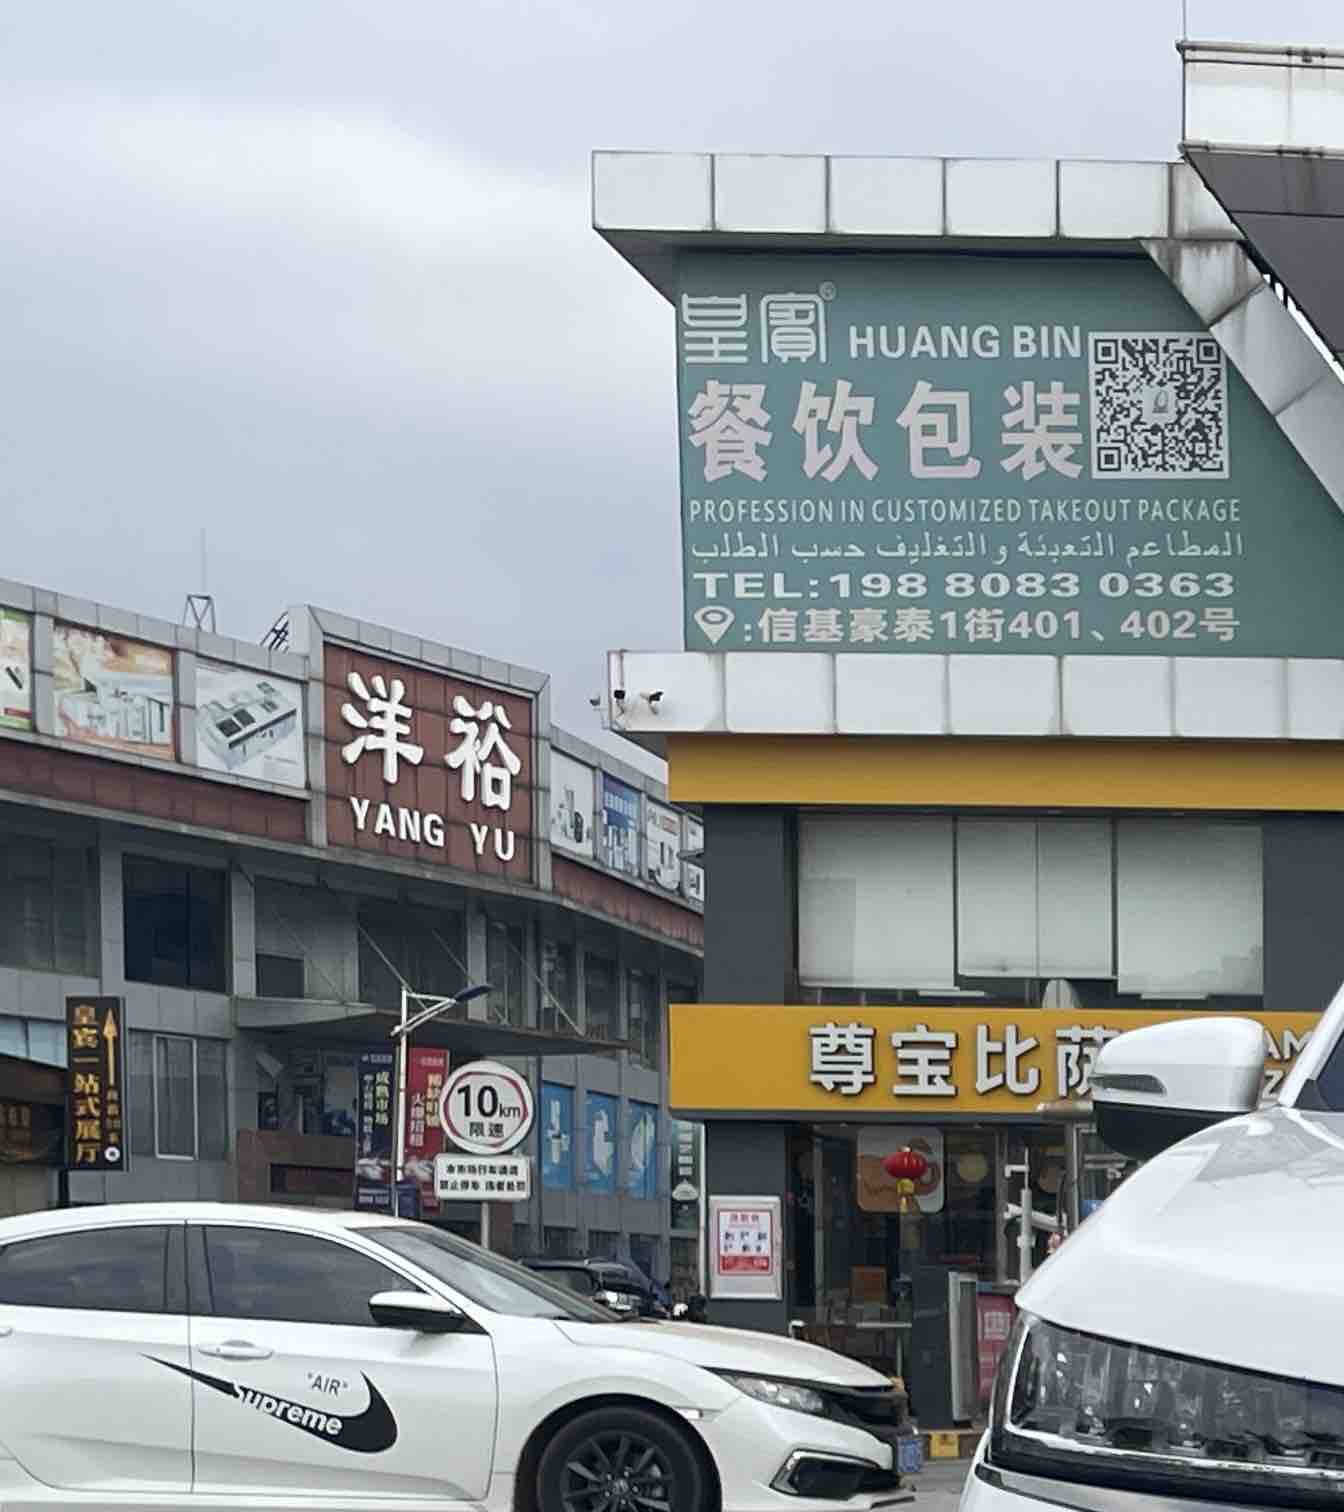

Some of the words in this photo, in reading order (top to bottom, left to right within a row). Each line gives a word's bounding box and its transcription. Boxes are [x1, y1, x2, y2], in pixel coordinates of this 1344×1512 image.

[848, 325, 1000, 361] HUANG
[1013, 325, 1082, 359] BIN
[687, 379, 1085, 483] 餐饮包装
[689, 498, 834, 523] PROFESSION
[840, 498, 866, 523] IN
[871, 498, 1022, 523] CUSTOMIZED
[1028, 498, 1132, 523] TAKEOUT
[1137, 498, 1241, 523] PACKAGE
[691, 530, 779, 565] الطلب
[790, 540, 866, 564] حسب
[1126, 528, 1243, 568] المطاعم
[944, 572, 1081, 599] 8083
[1098, 572, 1236, 599] 0363
[340, 670, 522, 812] 洋裕
[350, 796, 445, 848] YANG
[470, 822, 516, 862] YU
[469, 1121, 505, 1138] 限速
[233, 1382, 344, 1437] Supreme
